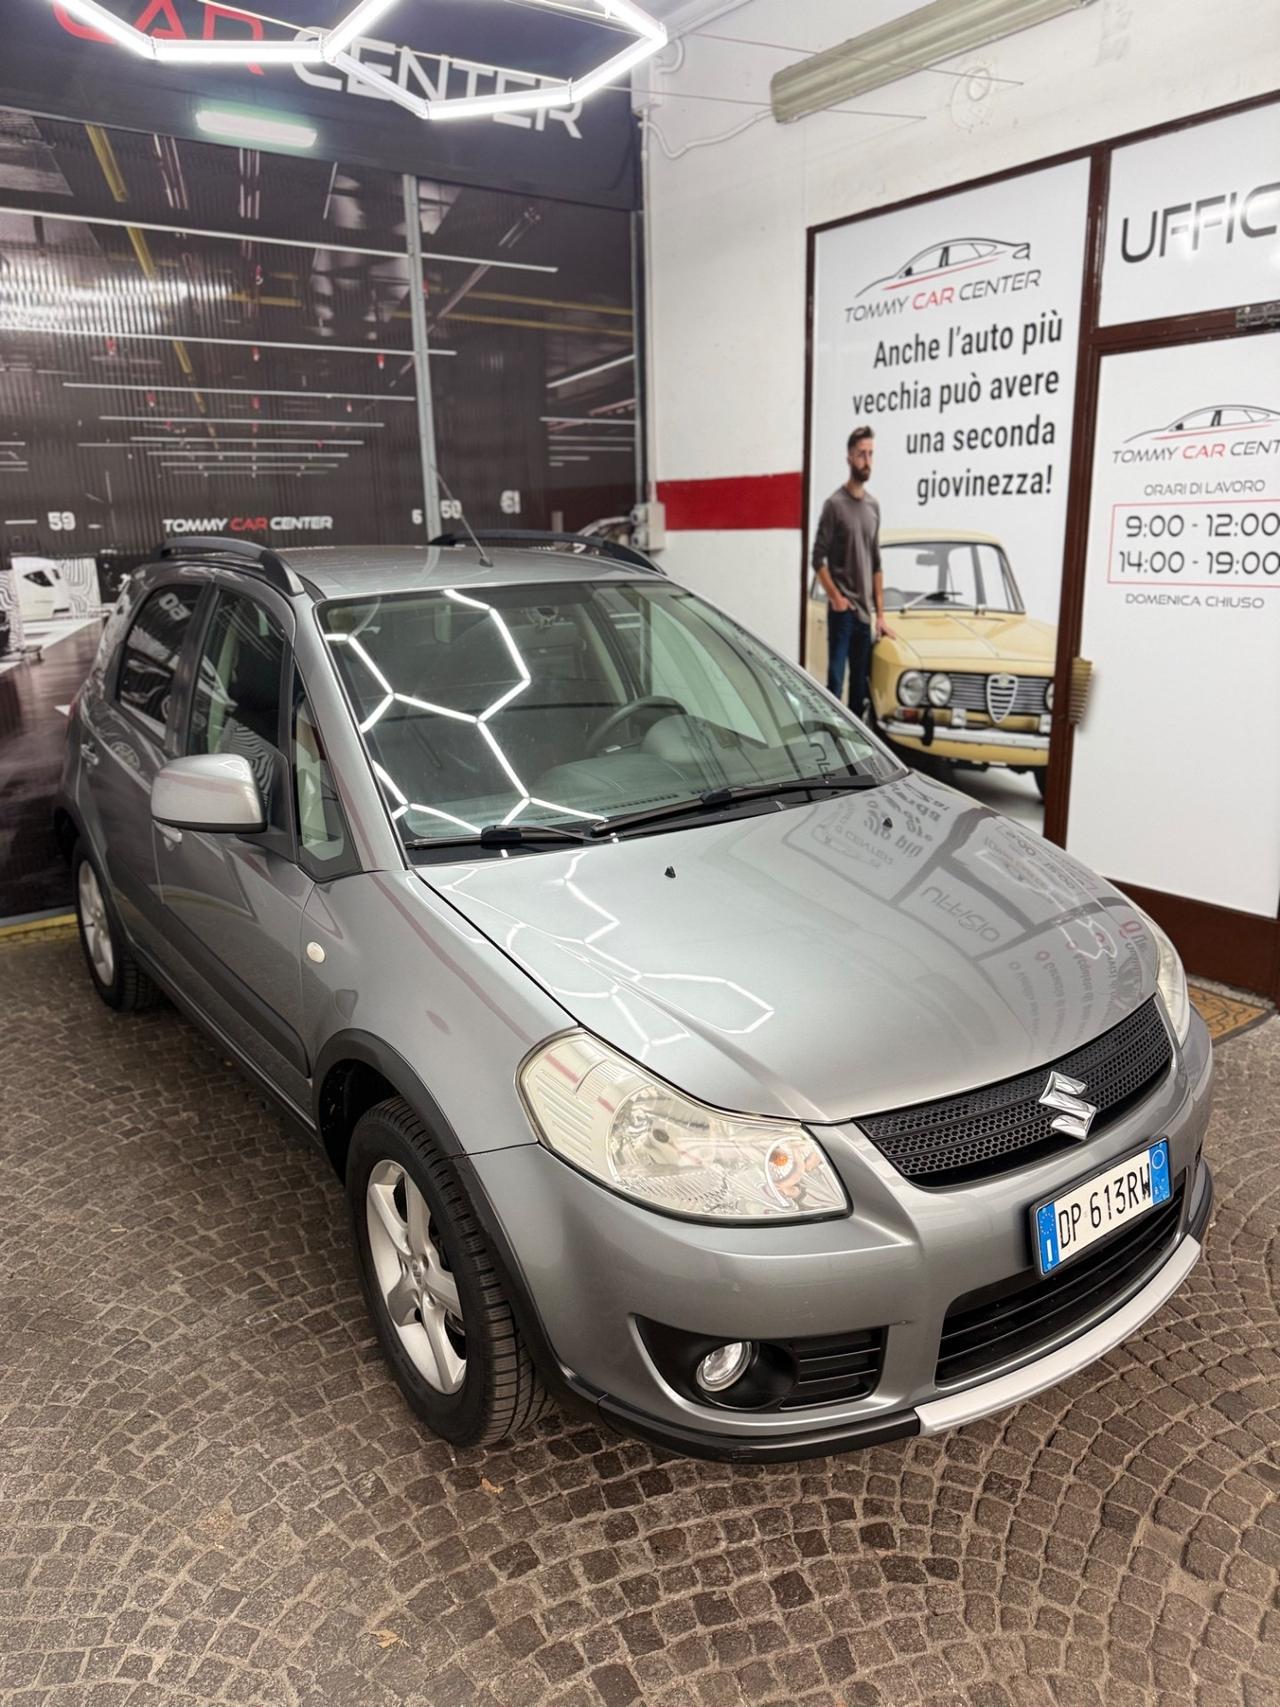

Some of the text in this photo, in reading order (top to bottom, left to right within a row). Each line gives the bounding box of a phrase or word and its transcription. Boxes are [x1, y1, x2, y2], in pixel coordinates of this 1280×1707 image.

[291, 26, 583, 139] CENTER
[1121, 181, 1280, 263] UFFIC
[844, 269, 1042, 323] TOMMY CAR CENTER
[873, 333, 940, 368] Anche
[1022, 309, 1063, 355] più
[852, 369, 1059, 415] vecchia può avere
[906, 414, 1056, 454] una seconda
[1112, 447, 1179, 463] TOMMY
[1182, 443, 1226, 460] CAR
[917, 464, 1052, 506] giovinezza!
[1144, 479, 1266, 496] ORARI DI LAVORO
[162, 515, 334, 533] TOMMY CAR CENTER
[1126, 515, 1185, 537] 9:00
[1206, 512, 1280, 537] 12:00
[1119, 551, 1185, 574] 14:00
[1206, 551, 1280, 575] 19:00
[1125, 593, 1265, 609] DOMENICA CHIUSO
[1058, 1163, 1151, 1249] DP 613RW
